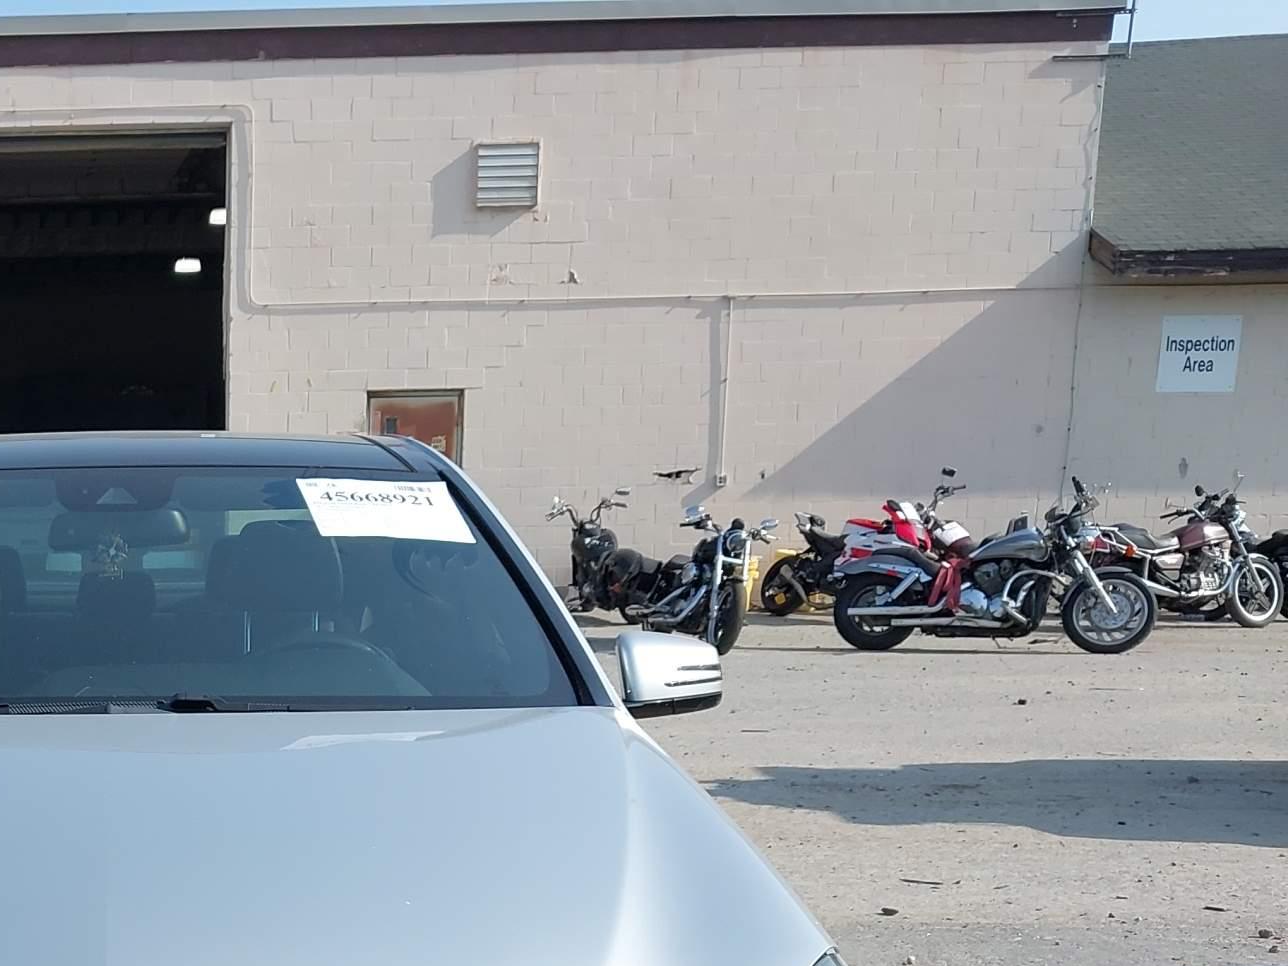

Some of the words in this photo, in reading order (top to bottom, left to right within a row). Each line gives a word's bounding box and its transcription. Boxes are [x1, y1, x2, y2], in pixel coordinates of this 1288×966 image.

[1166, 336, 1235, 355] Inspection
[1182, 356, 1214, 372] Area
[319, 491, 434, 506] 45668921
